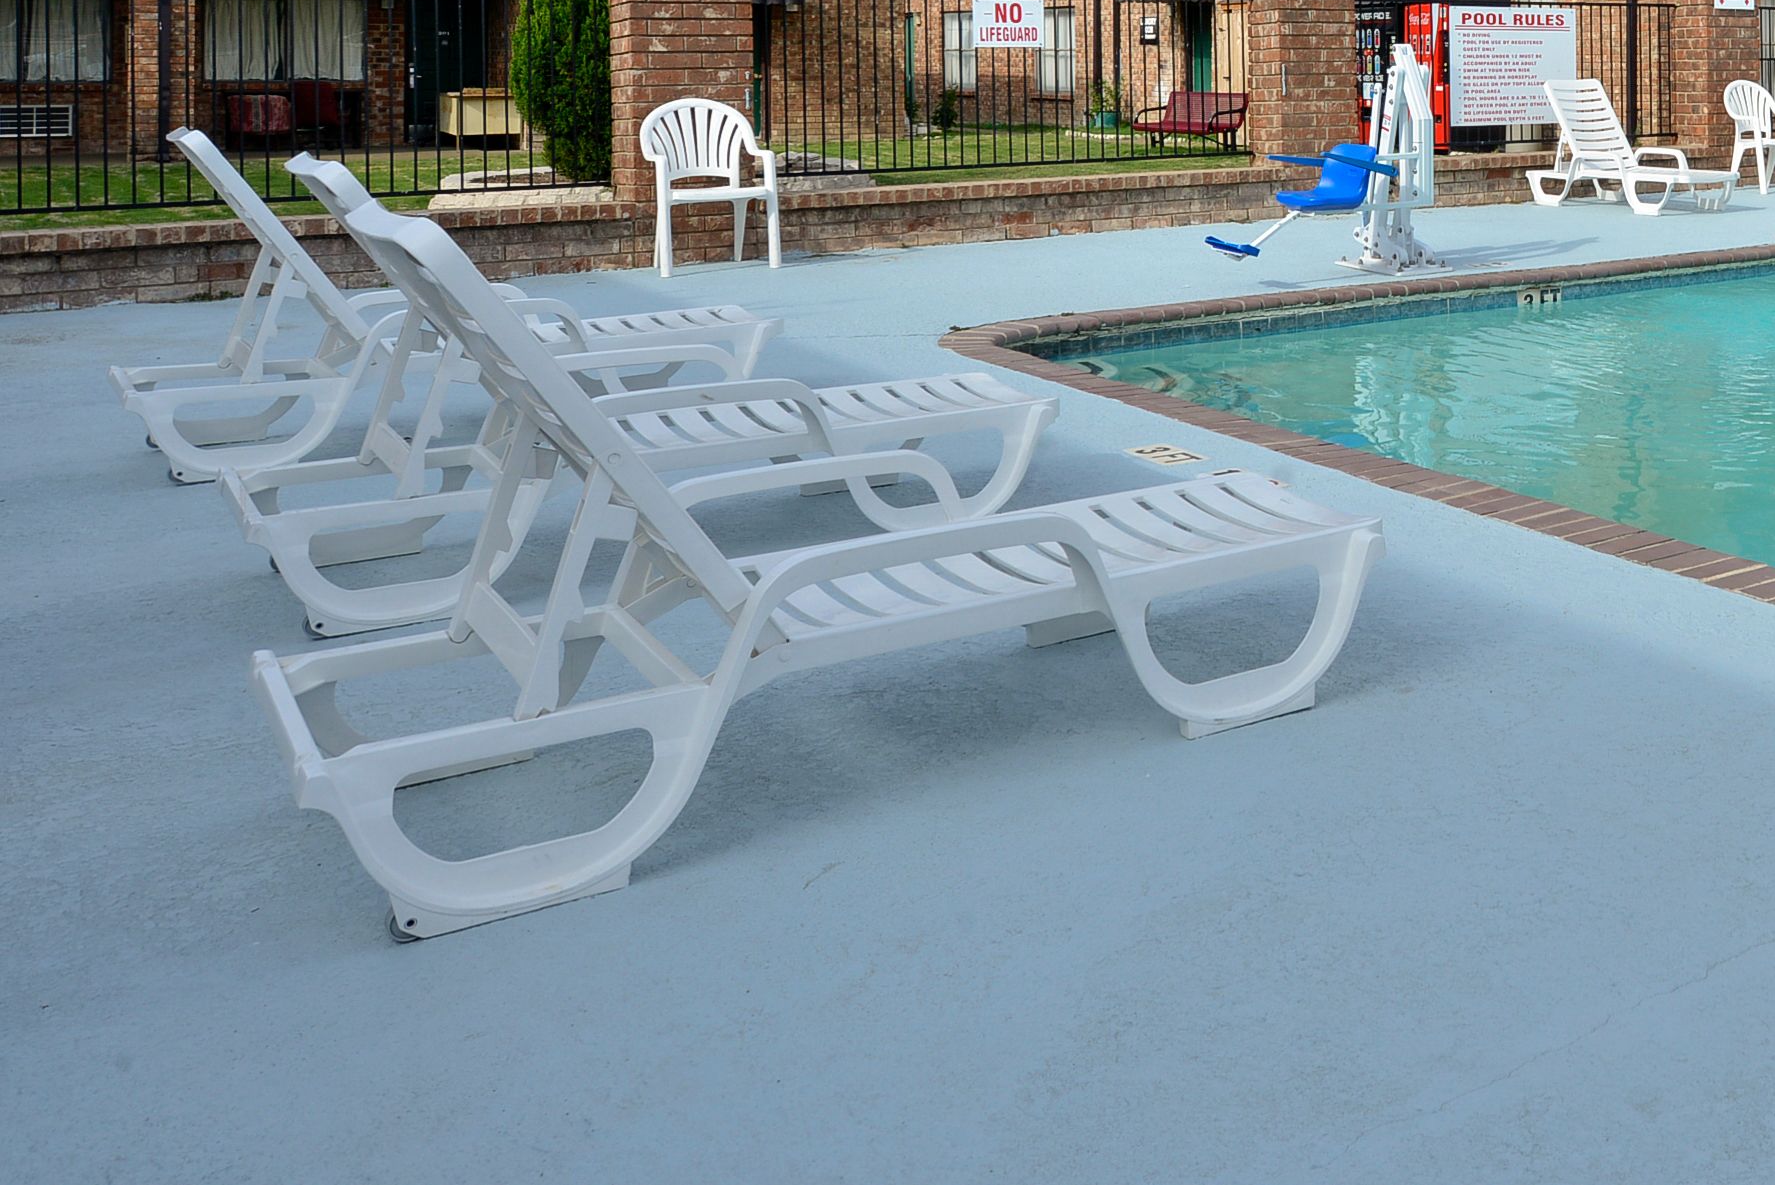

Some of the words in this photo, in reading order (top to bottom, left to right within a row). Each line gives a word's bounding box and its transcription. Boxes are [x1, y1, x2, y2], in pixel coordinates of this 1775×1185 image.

[994, 2, 1023, 24] NO
[1461, 13, 1507, 25] POOL
[1513, 13, 1565, 26] RULES
[979, 27, 1038, 42] LIFEGUARD
[1540, 289, 1561, 304] FT
[1135, 446, 1171, 455] 3
[1152, 452, 1203, 464] FT
